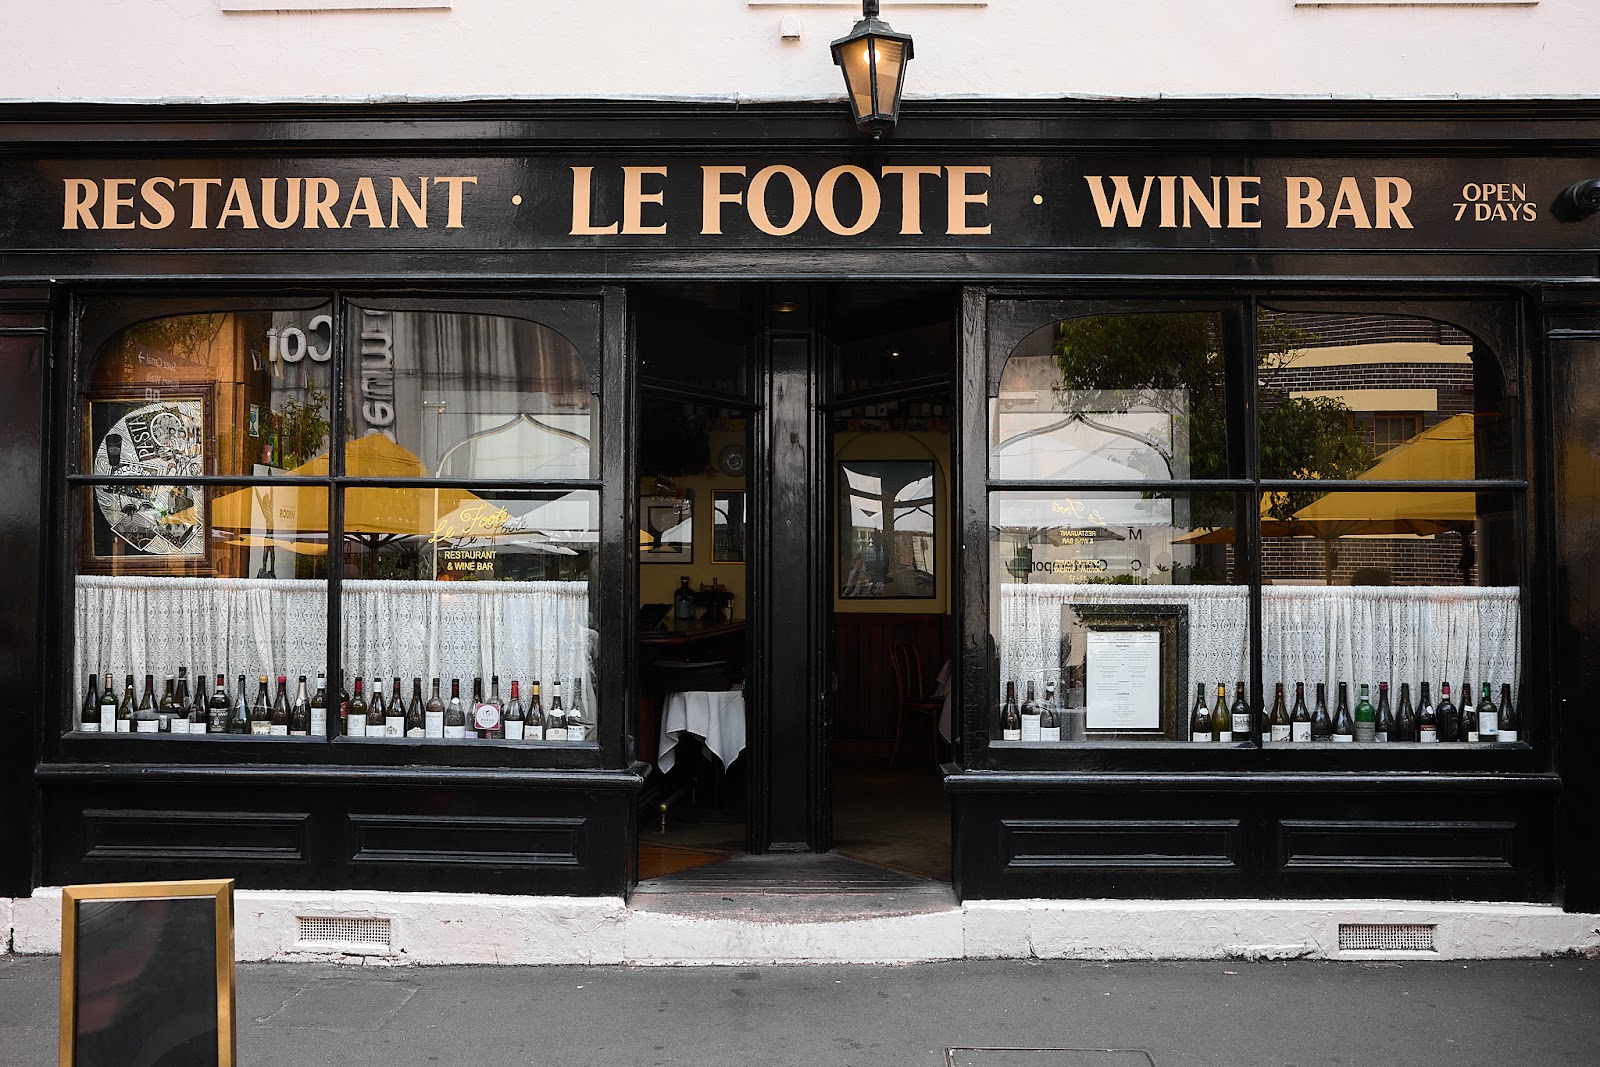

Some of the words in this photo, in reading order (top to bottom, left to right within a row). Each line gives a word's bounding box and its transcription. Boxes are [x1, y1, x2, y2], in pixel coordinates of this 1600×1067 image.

[62, 176, 478, 231] RESTAURANT
[569, 165, 668, 236] LE
[701, 164, 992, 237] FOOTE
[1084, 175, 1261, 228] WINE
[1285, 175, 1413, 229] BAR
[1462, 183, 1527, 202] OPEN
[1453, 203, 1467, 221] 7
[1475, 203, 1538, 221] DAYS
[128, 414, 156, 460] PASTA
[279, 508, 296, 520] RODIN
[427, 519, 455, 544] Le
[460, 503, 510, 534] Foote
[444, 550, 497, 560] RESTAURANT
[447, 561, 453, 571] &
[454, 561, 475, 571] WINE
[477, 561, 494, 571] BAR
